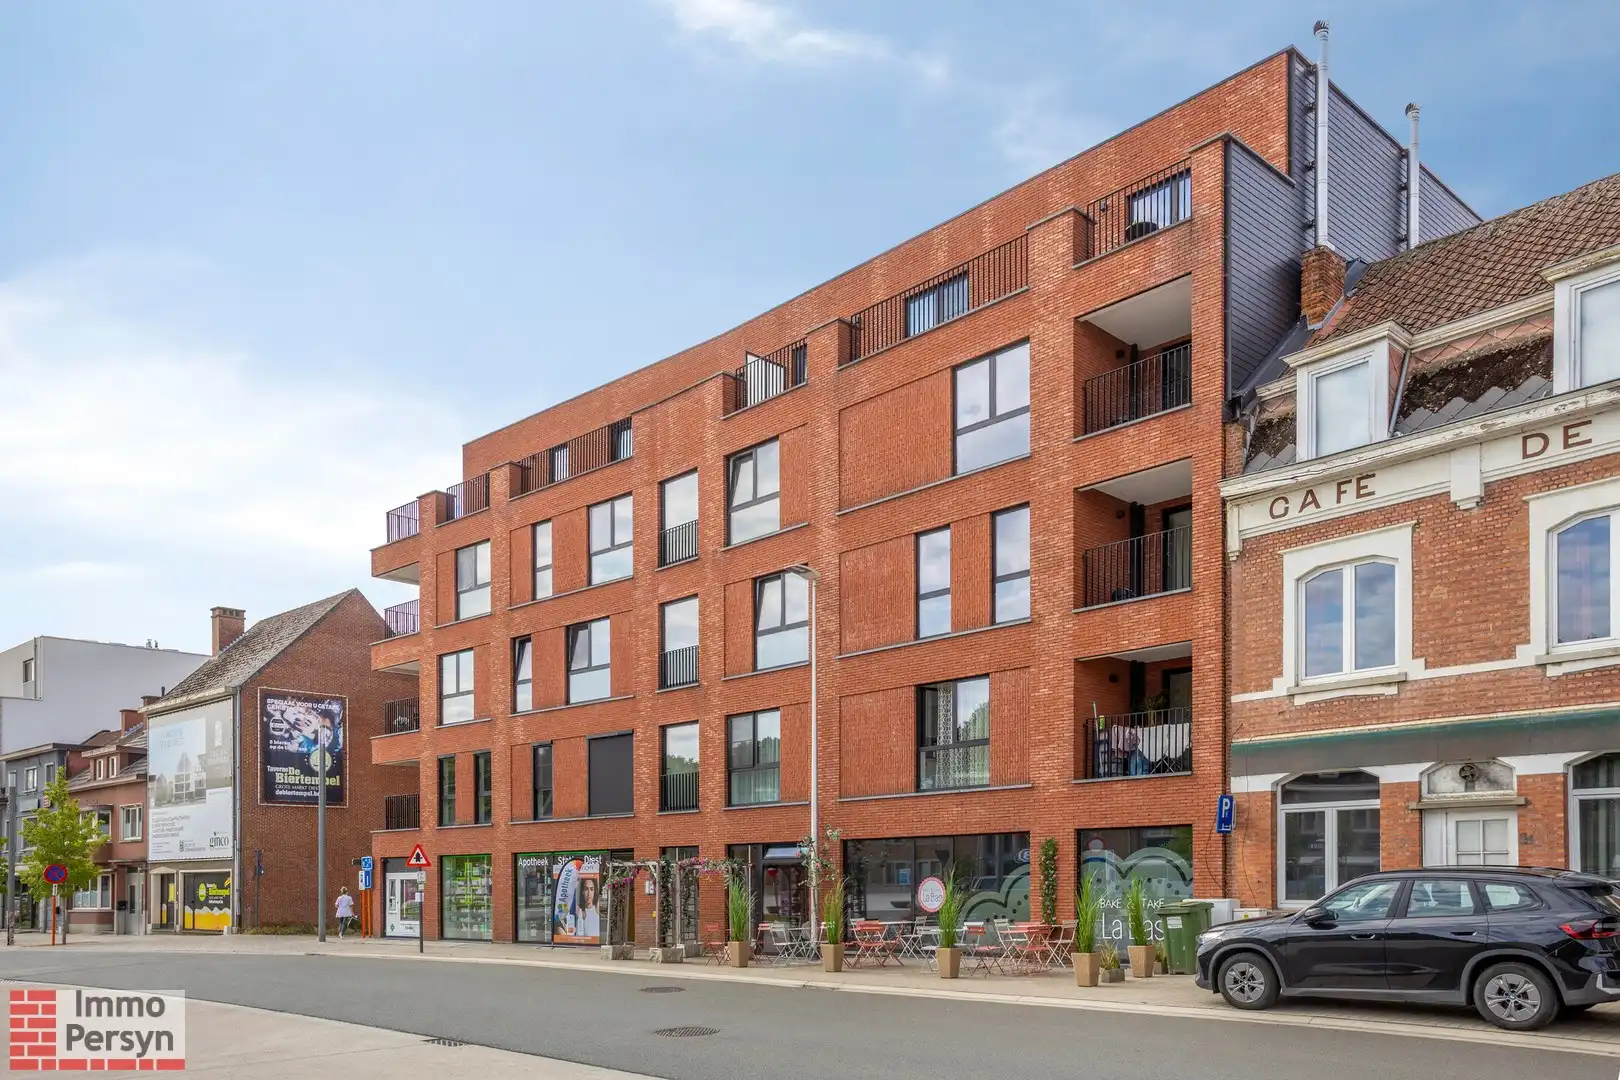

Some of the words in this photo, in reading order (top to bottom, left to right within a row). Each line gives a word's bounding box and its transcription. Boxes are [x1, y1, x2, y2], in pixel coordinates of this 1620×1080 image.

[1269, 473, 1376, 519] CAFE
[1522, 420, 1592, 460] DE
[267, 765, 288, 773] Taverne
[288, 766, 301, 775] De
[275, 773, 340, 786] Biertemel
[1222, 798, 1231, 818] P
[518, 857, 549, 868] Apotheek
[583, 855, 602, 865] Diest
[559, 868, 573, 902] Apotheek
[1099, 898, 1122, 909] BAKE
[1142, 898, 1165, 909] TAKE
[1102, 912, 1123, 940] La
